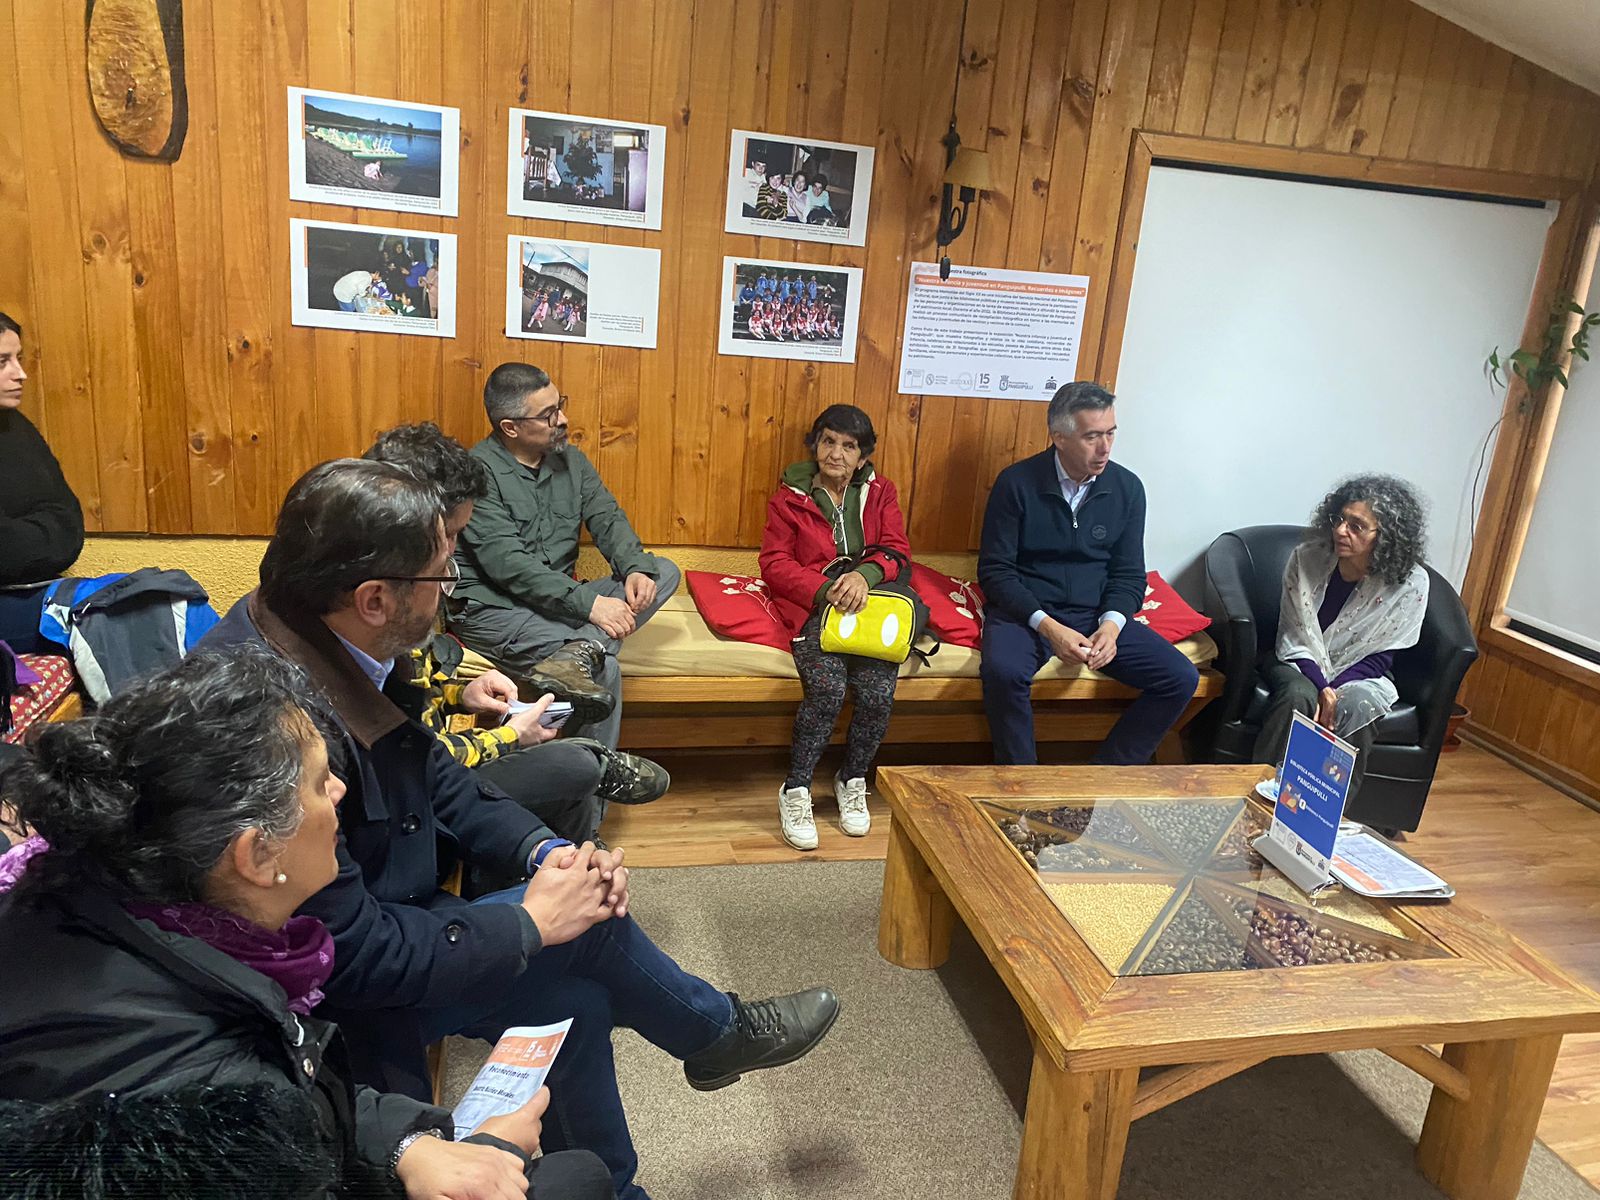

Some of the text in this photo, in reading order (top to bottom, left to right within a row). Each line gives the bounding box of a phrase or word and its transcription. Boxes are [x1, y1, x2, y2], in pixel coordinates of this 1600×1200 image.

[979, 373, 990, 385] 15
[1290, 759, 1308, 775] BIBLIOTECA
[1296, 776, 1328, 802] PANGUIPULLI
[488, 1065, 530, 1079] Reconocimiento
